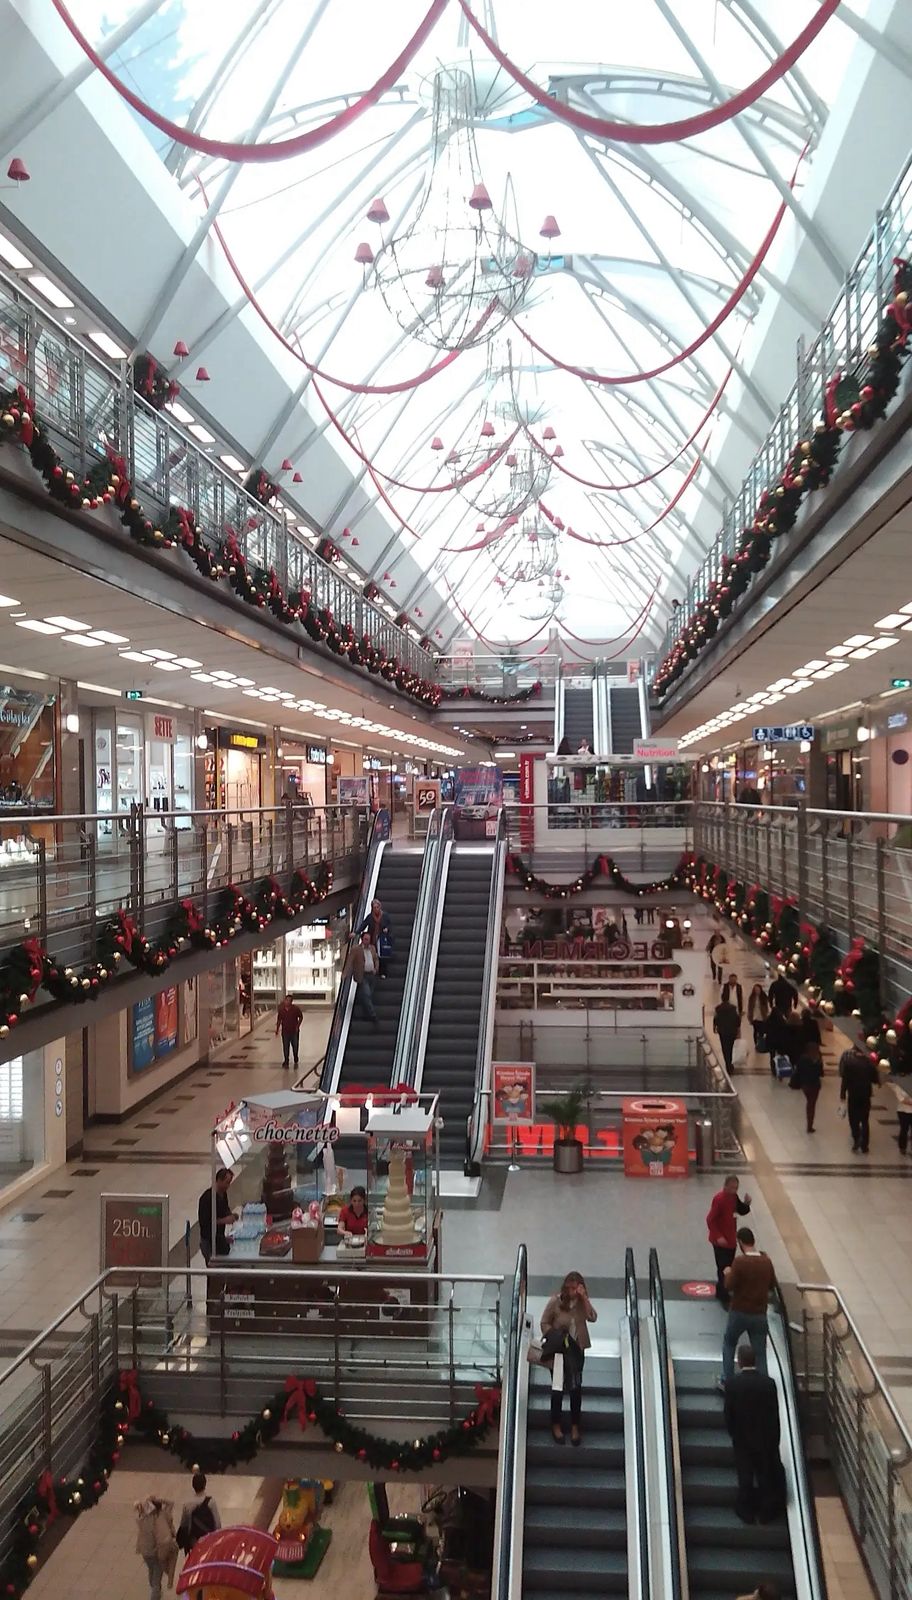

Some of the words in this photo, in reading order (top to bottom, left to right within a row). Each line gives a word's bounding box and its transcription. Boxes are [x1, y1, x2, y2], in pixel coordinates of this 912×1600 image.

[154, 716, 173, 738] SETTE
[637, 748, 676, 758] Nutrition
[419, 790, 437, 806] 50
